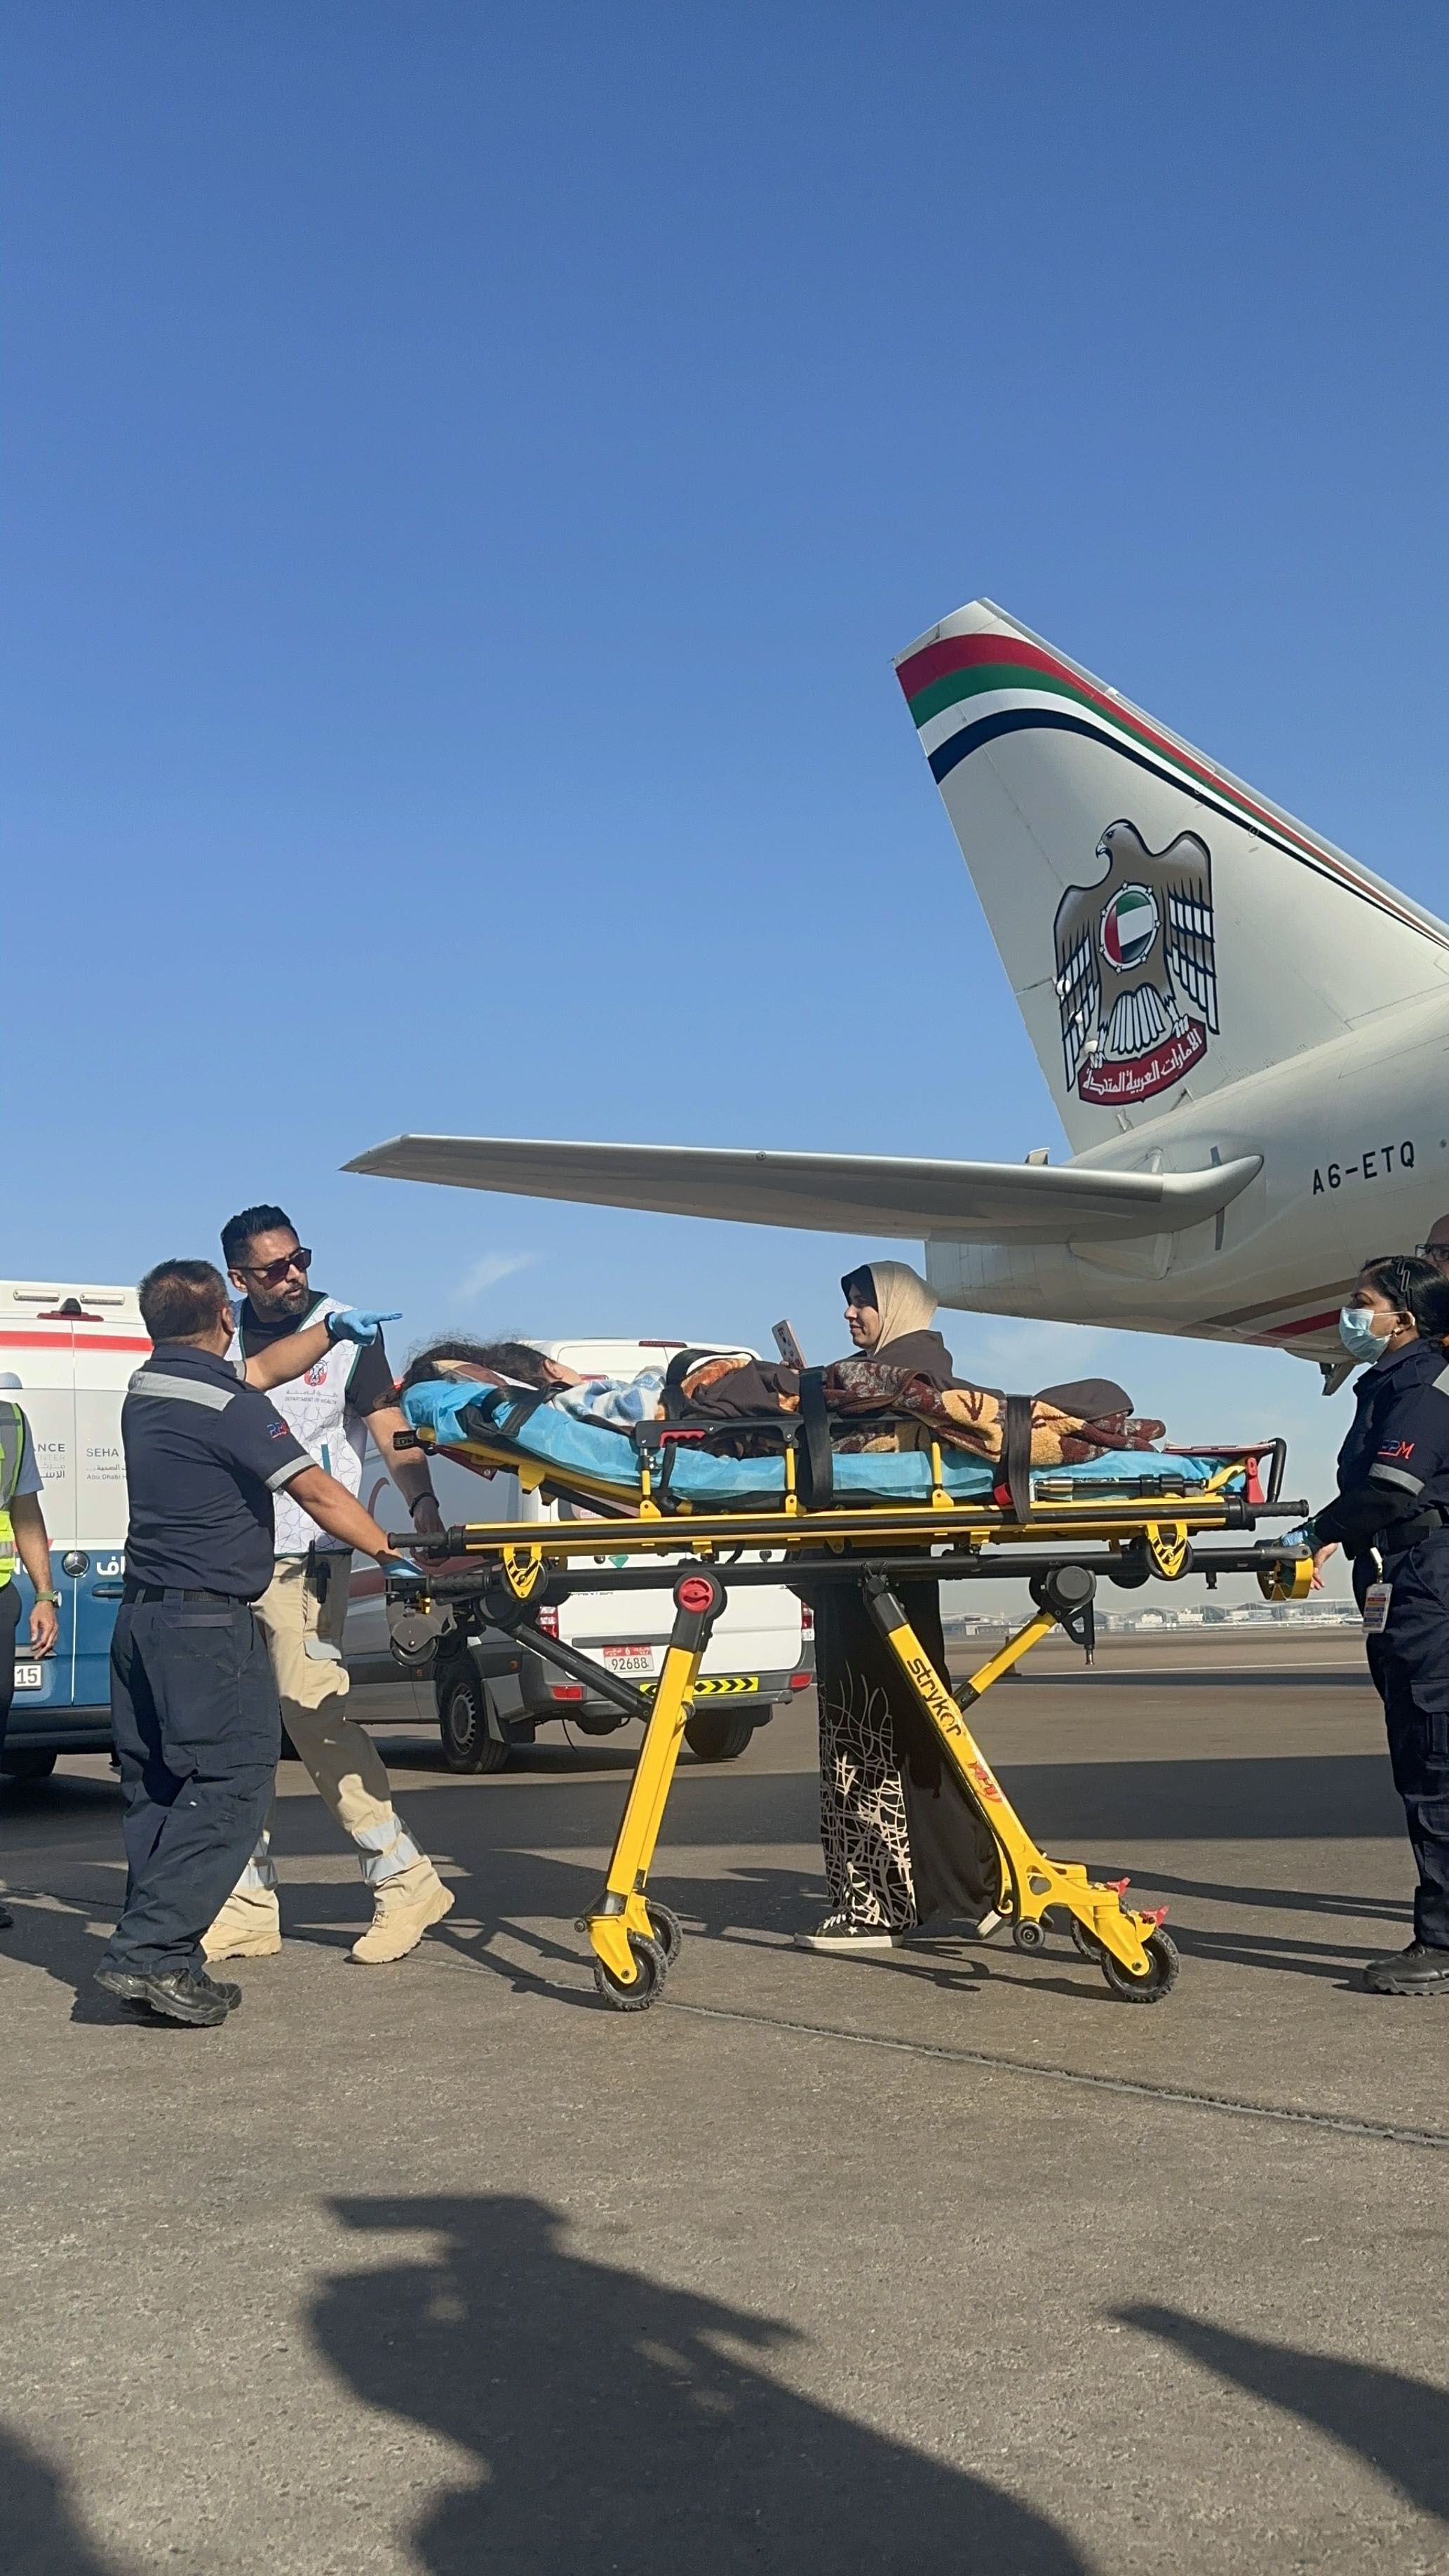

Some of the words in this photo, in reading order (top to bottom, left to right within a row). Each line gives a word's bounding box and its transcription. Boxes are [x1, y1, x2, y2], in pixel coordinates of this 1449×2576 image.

[1312, 1141, 1415, 1195] A6-ETQ
[37, 1443, 65, 1452] NCE
[86, 1448, 119, 1457] SEHA
[625, 1646, 631, 1655] 6
[612, 1657, 647, 1671] 92688
[16, 1668, 38, 1684] 15
